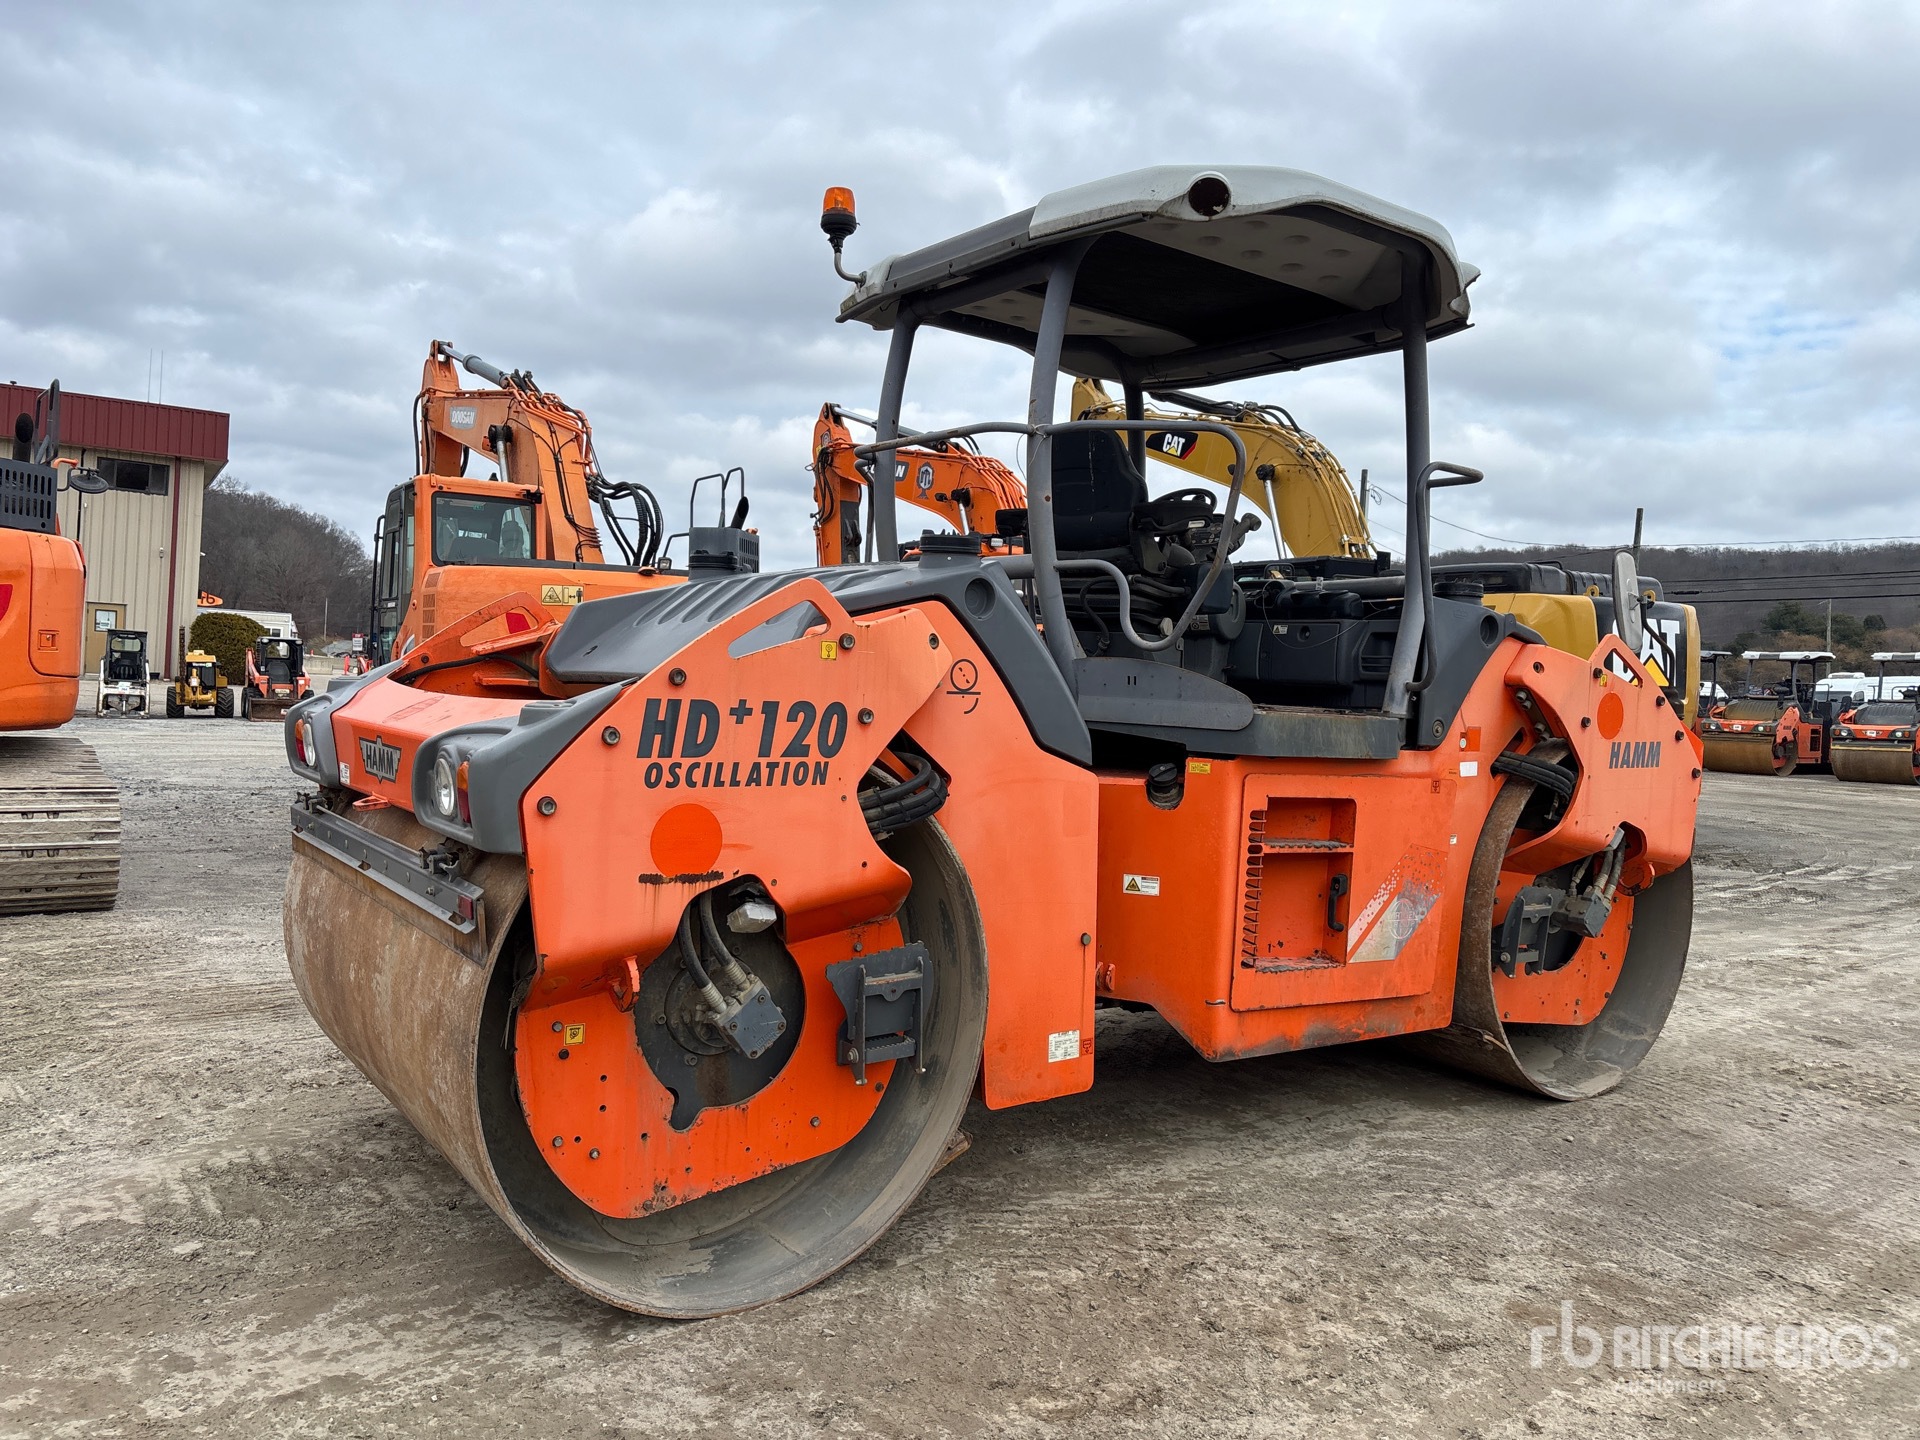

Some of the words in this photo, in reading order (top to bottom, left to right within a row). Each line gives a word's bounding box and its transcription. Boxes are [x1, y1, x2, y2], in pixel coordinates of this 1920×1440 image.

[451, 410, 475, 425] DOOSAN
[1162, 433, 1186, 457] CAT
[365, 744, 395, 777] HAMM
[1609, 741, 1661, 769] HAMM
[644, 760, 830, 789] OSCILLATION
